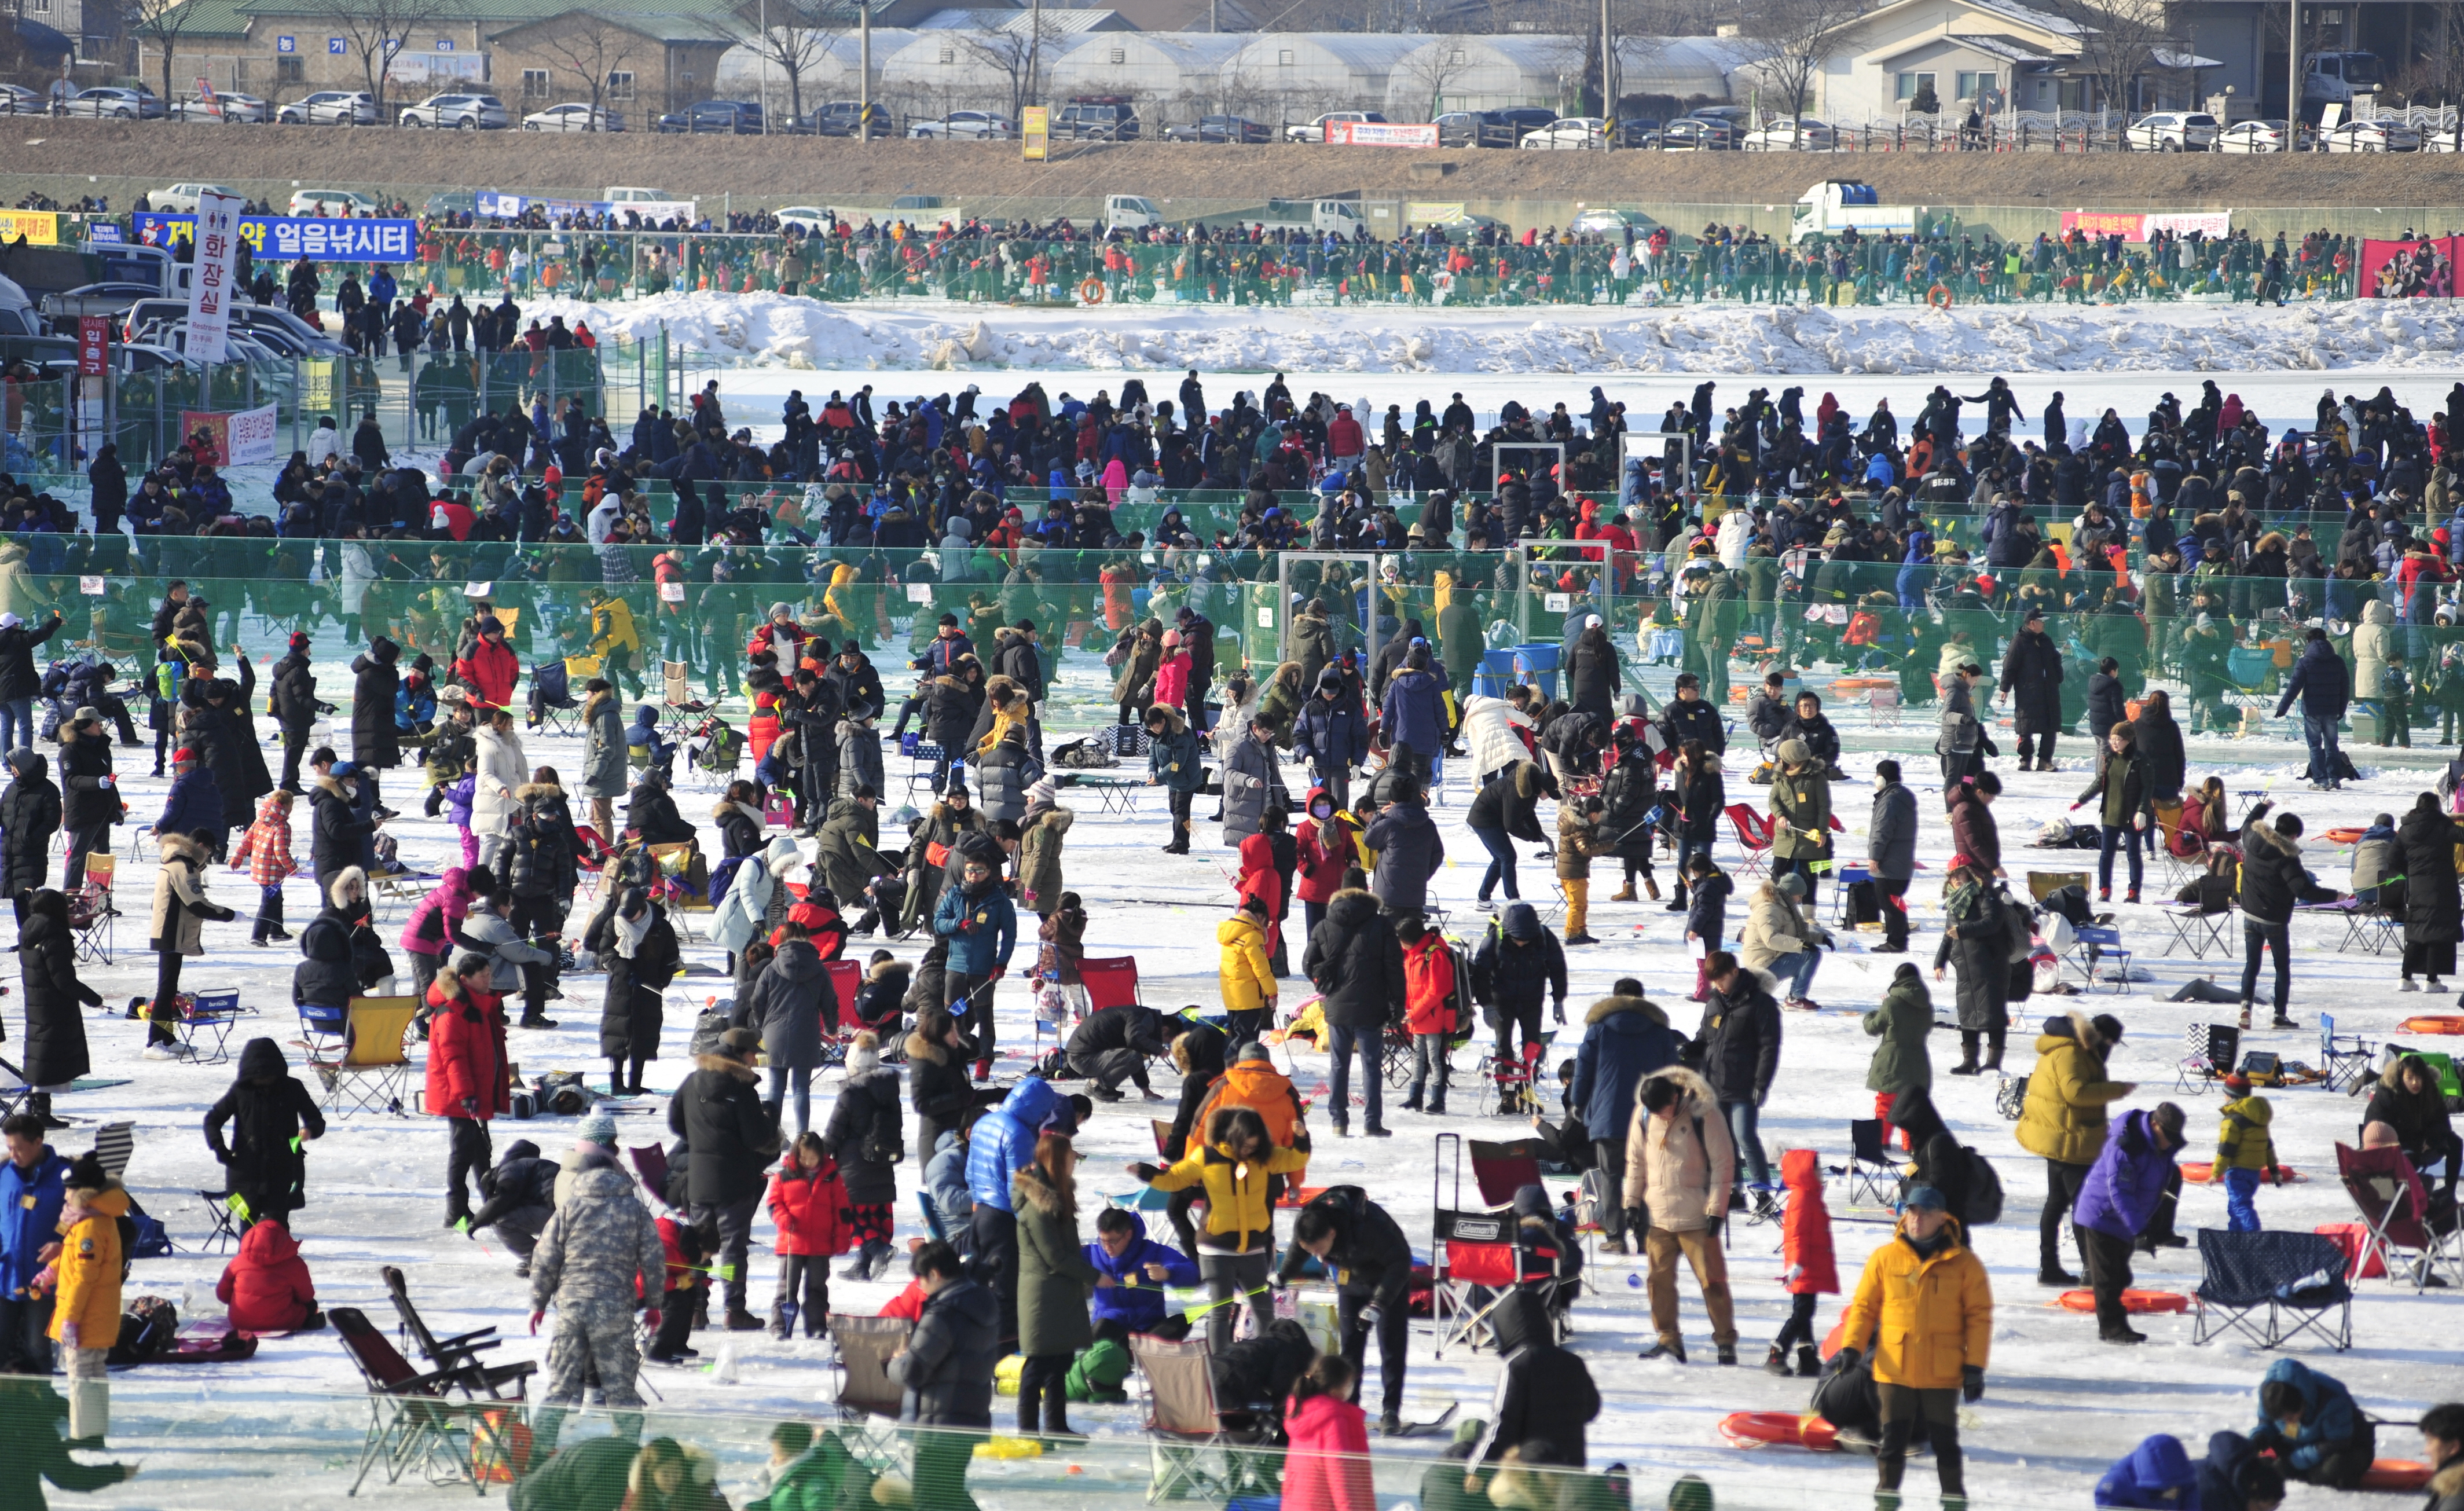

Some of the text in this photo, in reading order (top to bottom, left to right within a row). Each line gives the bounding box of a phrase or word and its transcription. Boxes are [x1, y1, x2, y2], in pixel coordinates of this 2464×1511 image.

[274, 222, 408, 255] 얼음낚시터
[200, 234, 228, 315] 화장실
[82, 318, 106, 329] 낚시터
[192, 322, 222, 332] Restroom
[1932, 478, 1956, 487] BEST
[1459, 1224, 1490, 1235] Coleman
